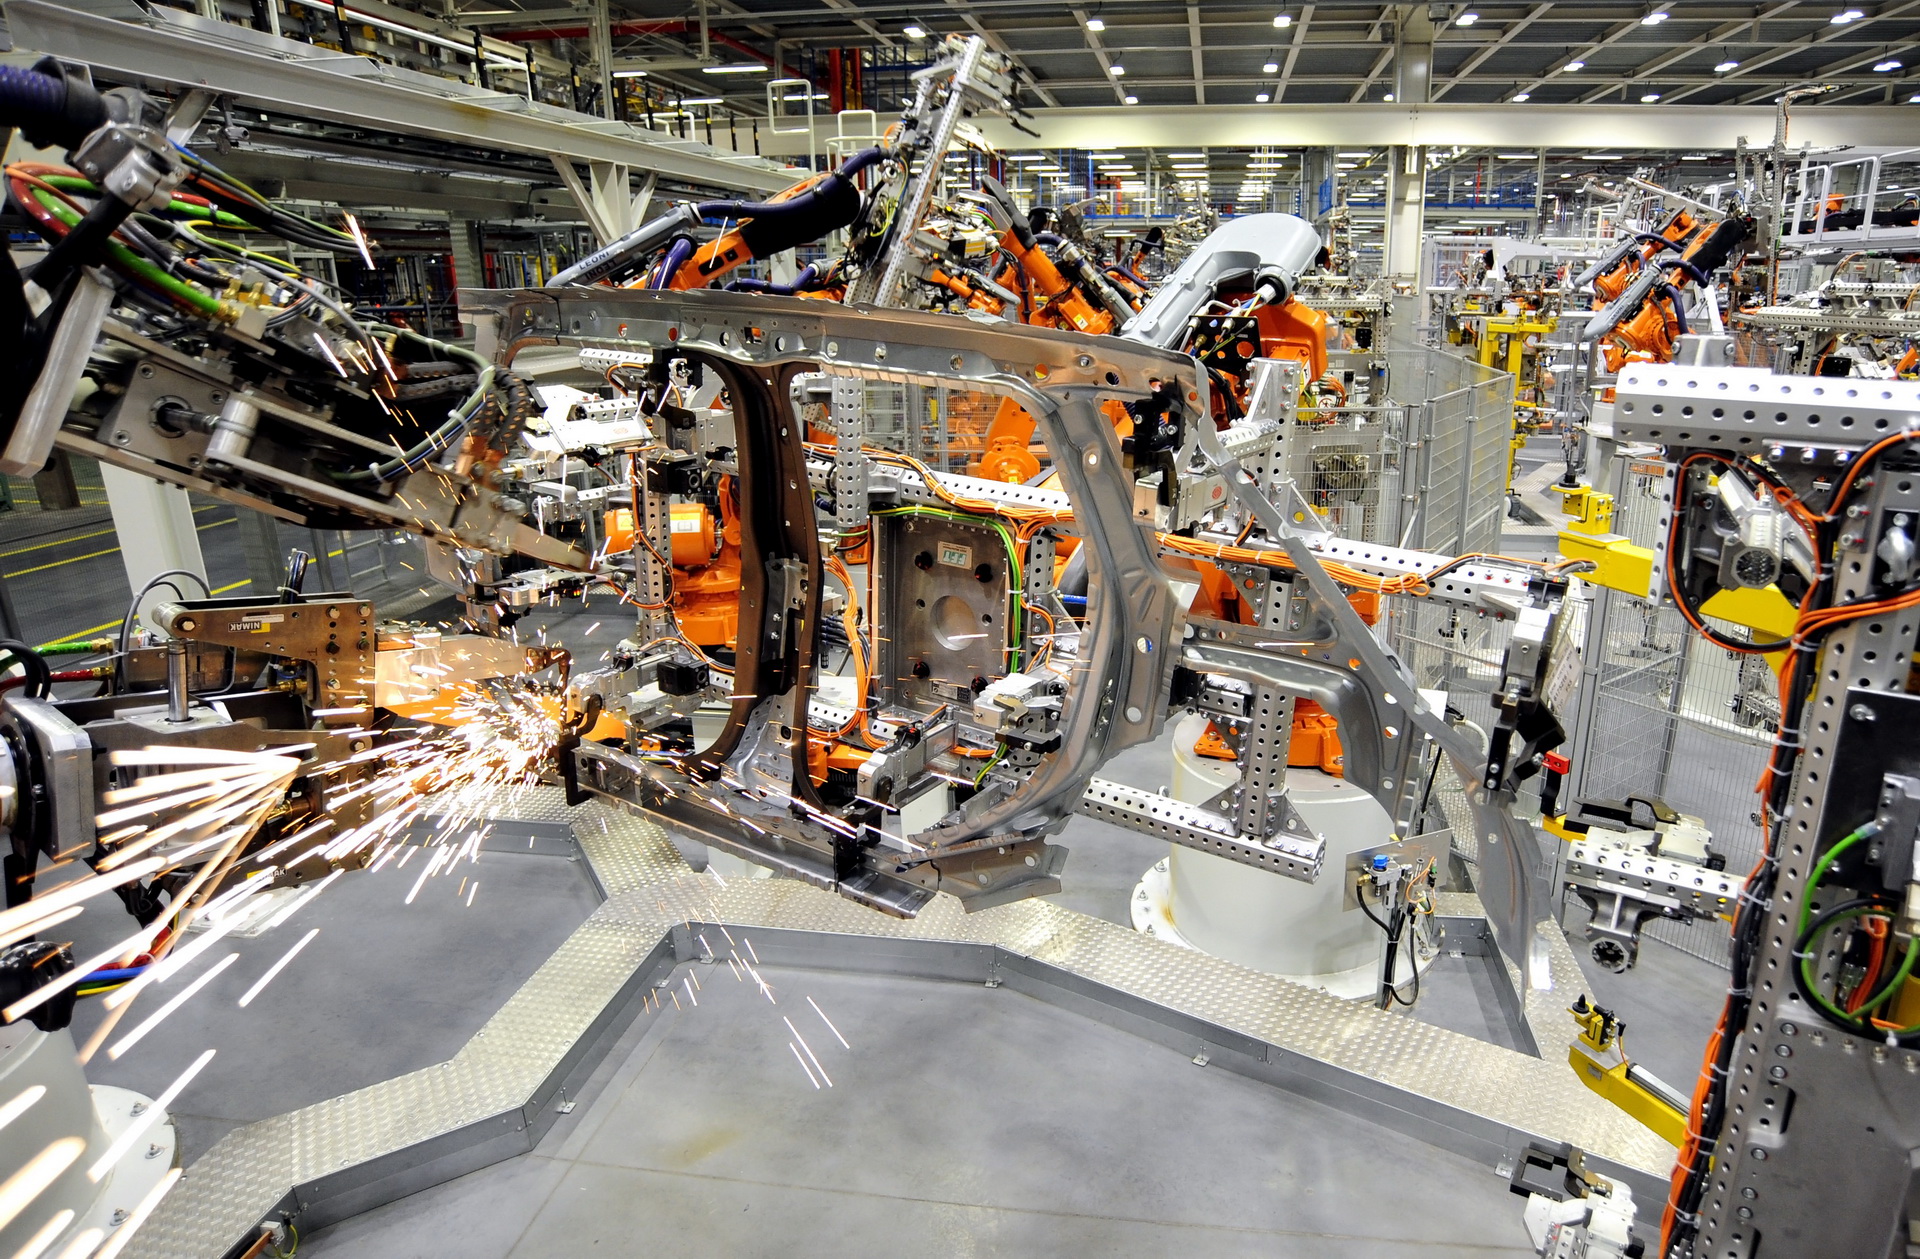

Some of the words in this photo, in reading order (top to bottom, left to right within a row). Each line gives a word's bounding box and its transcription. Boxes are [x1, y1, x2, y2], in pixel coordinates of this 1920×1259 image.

[579, 251, 610, 270] LEONI
[585, 259, 617, 279] LEONI
[230, 621, 261, 631] NIMAK
